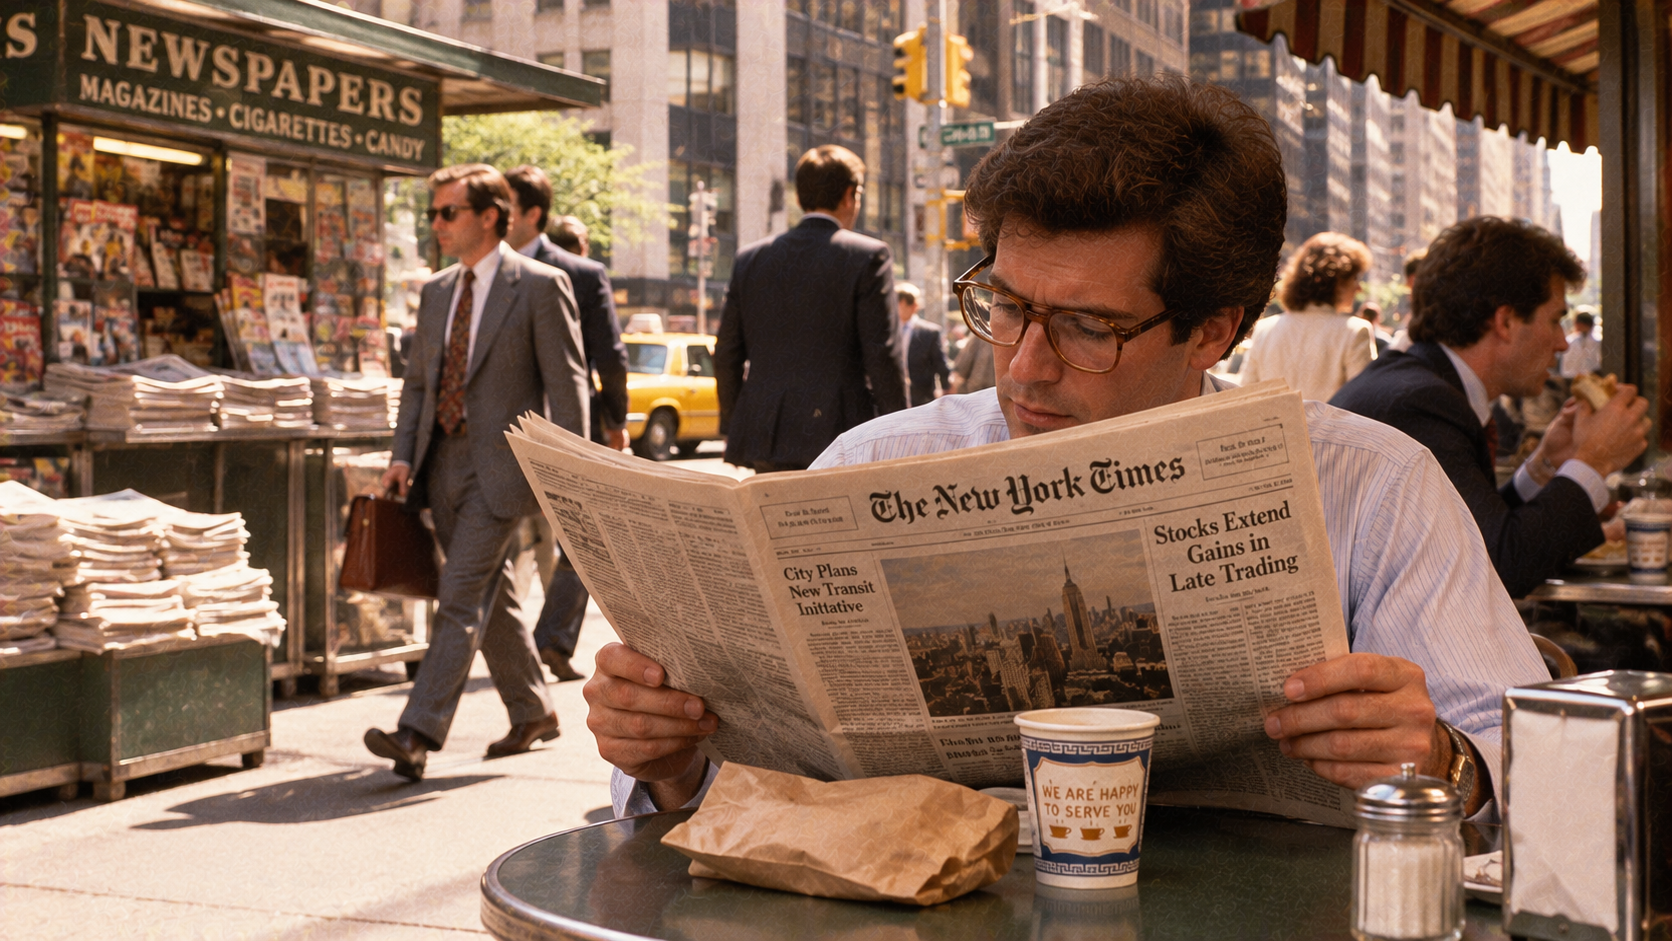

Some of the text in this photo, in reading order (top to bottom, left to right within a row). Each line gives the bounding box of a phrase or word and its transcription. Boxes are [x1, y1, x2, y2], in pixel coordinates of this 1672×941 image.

[0, 12, 38, 59] S
[81, 13, 424, 127] NEWSPAPERS
[79, 74, 426, 162] MAGAZINES CIGARETTES CANDY
[869, 457, 1186, 524] The New York Times
[1154, 500, 1292, 545] Stocks Extend
[1187, 533, 1271, 564] Gains in
[783, 563, 858, 583] City Plans
[788, 580, 876, 599] New Transit
[1169, 555, 1299, 593] Late Trading
[1042, 783, 1139, 801] WE ARE HAPPY
[1044, 802, 1137, 818] TO SERVE YOU
